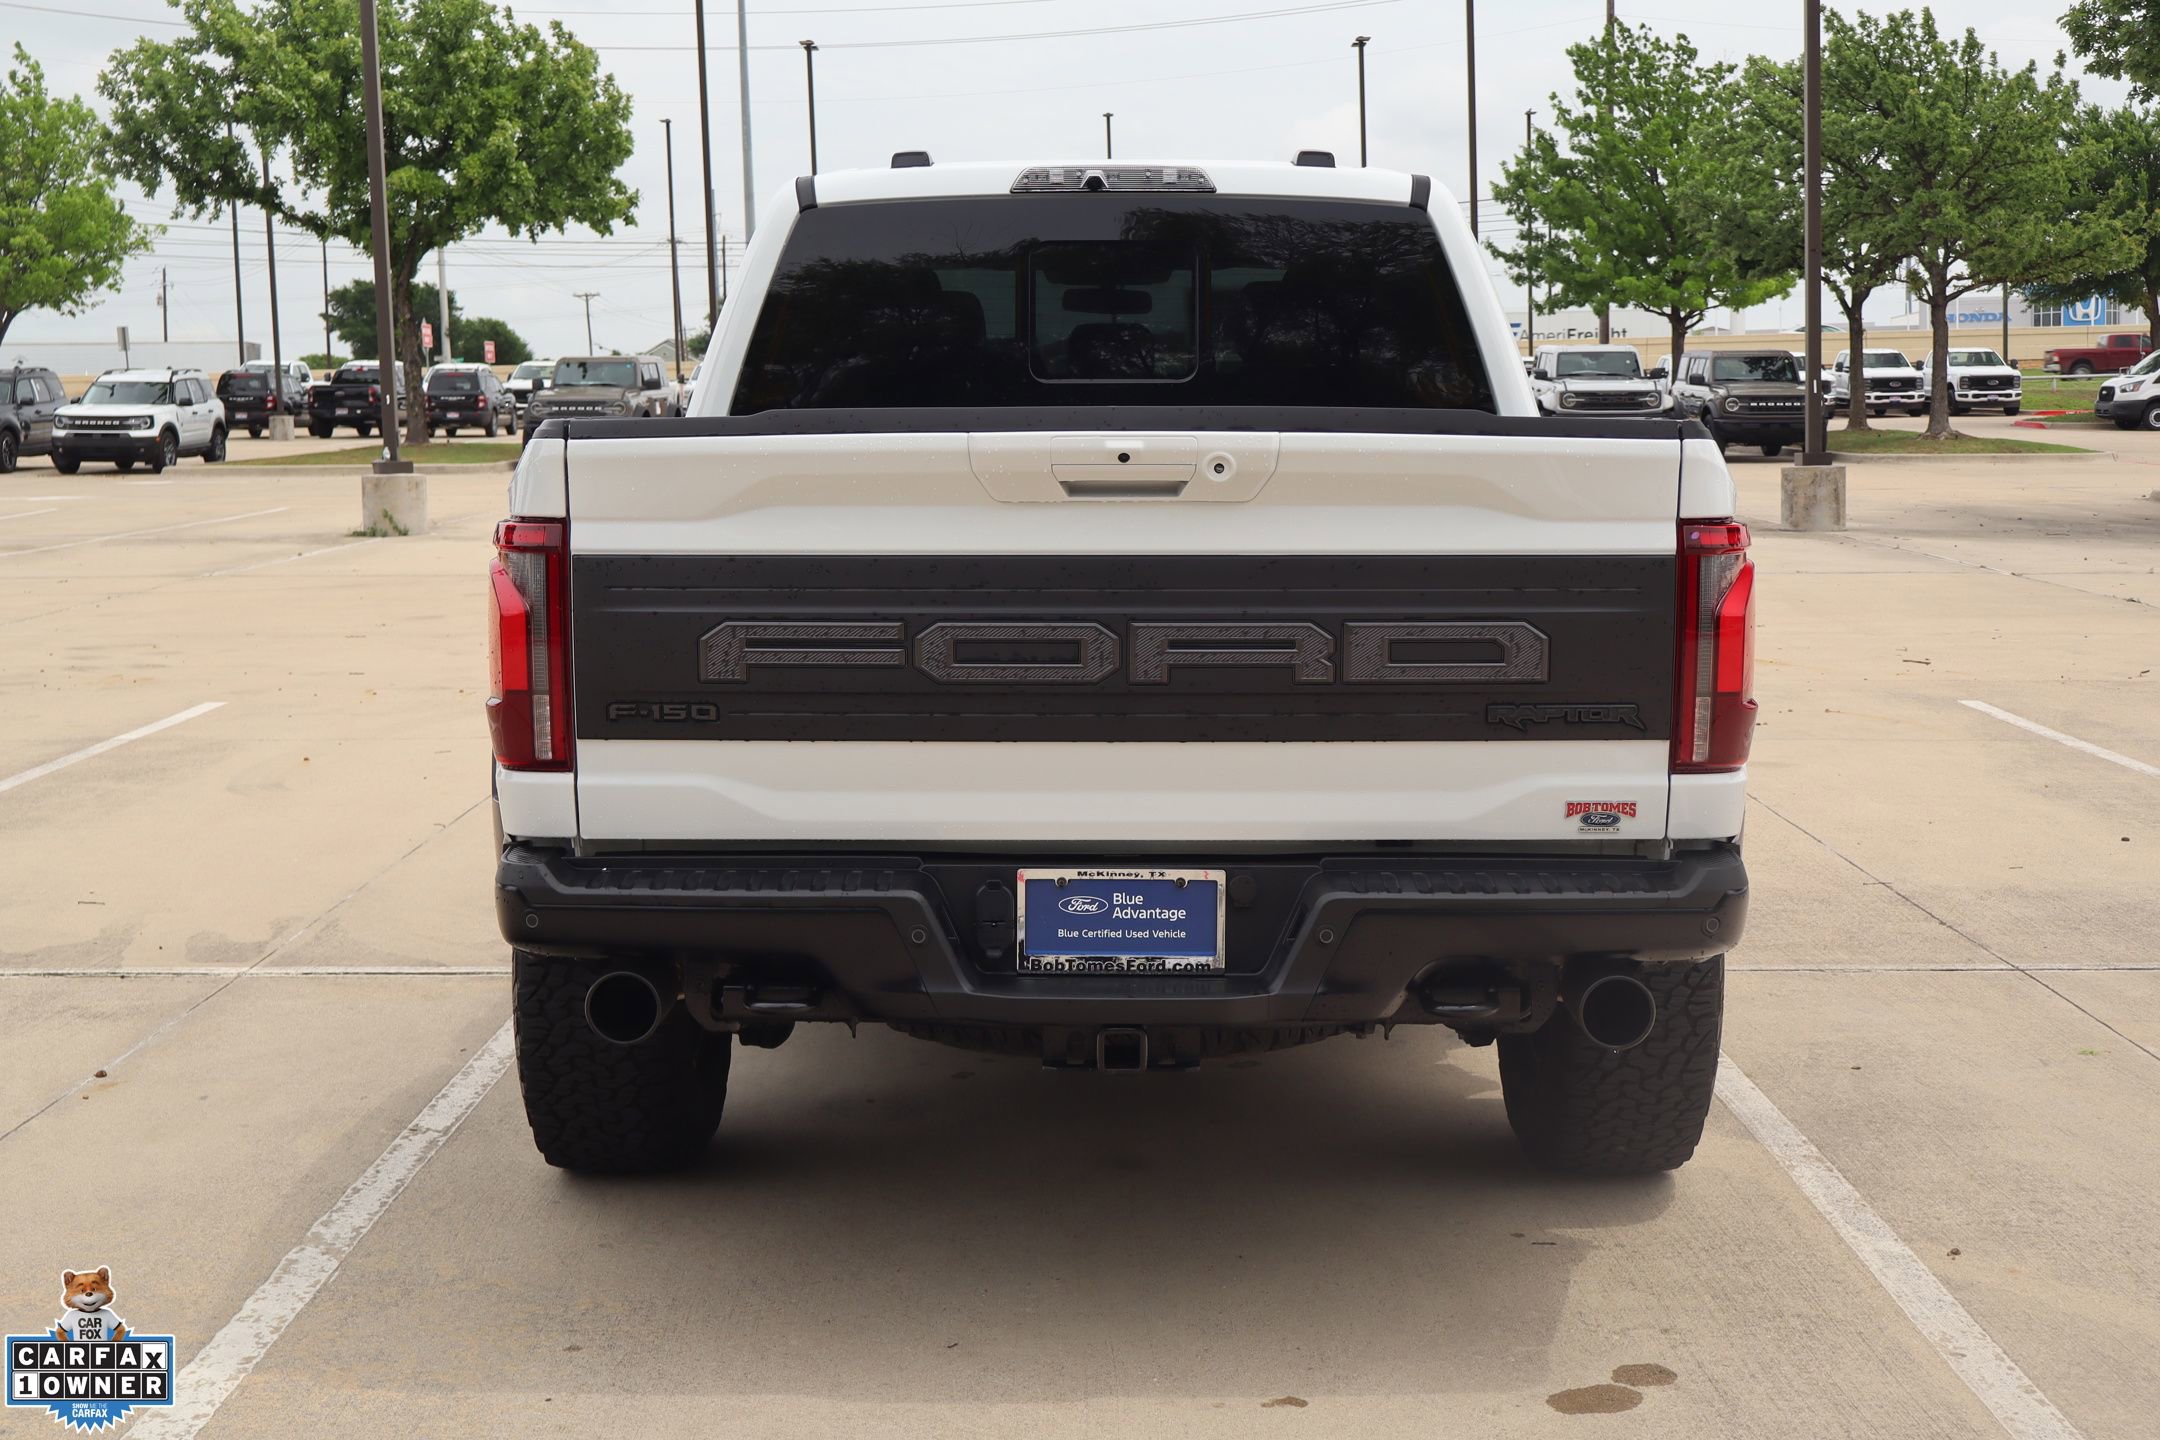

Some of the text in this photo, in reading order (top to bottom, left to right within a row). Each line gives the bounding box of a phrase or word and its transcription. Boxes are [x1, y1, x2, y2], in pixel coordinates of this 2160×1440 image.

[1520, 322, 1628, 340] AmeriFreiht
[700, 620, 1551, 685] FORD
[608, 703, 718, 721] F-150
[1486, 703, 1648, 732] RAPTOR
[1077, 871, 1144, 879] McKinney,
[1067, 899, 1099, 912] Ford
[1113, 893, 1144, 905] Blue
[1112, 907, 1187, 921] Advantage
[1057, 929, 1186, 938] Blue Certified Used Vehicle
[1030, 958, 1212, 973] BobTomesFord.com
